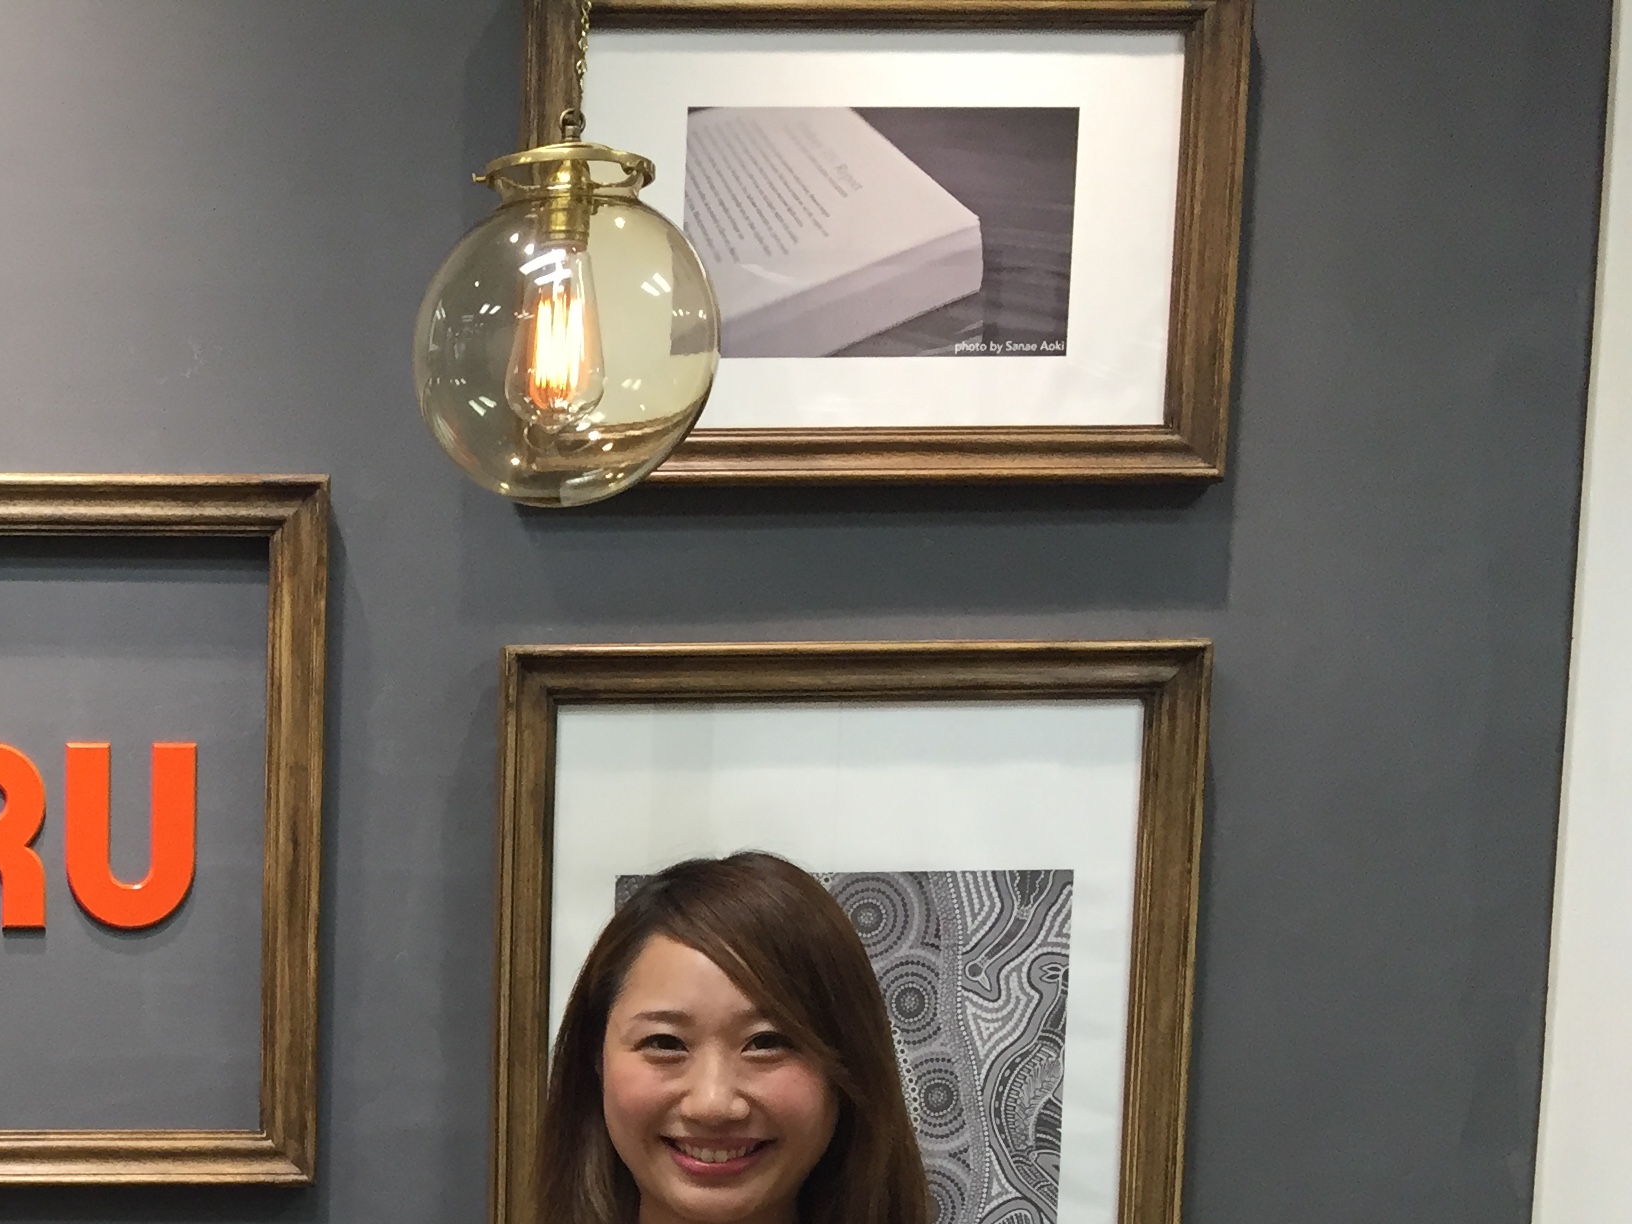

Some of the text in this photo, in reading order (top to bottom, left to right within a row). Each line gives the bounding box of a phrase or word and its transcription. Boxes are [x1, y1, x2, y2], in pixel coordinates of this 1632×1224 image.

[954, 340, 1065, 354] photo by Sanae Aoki
